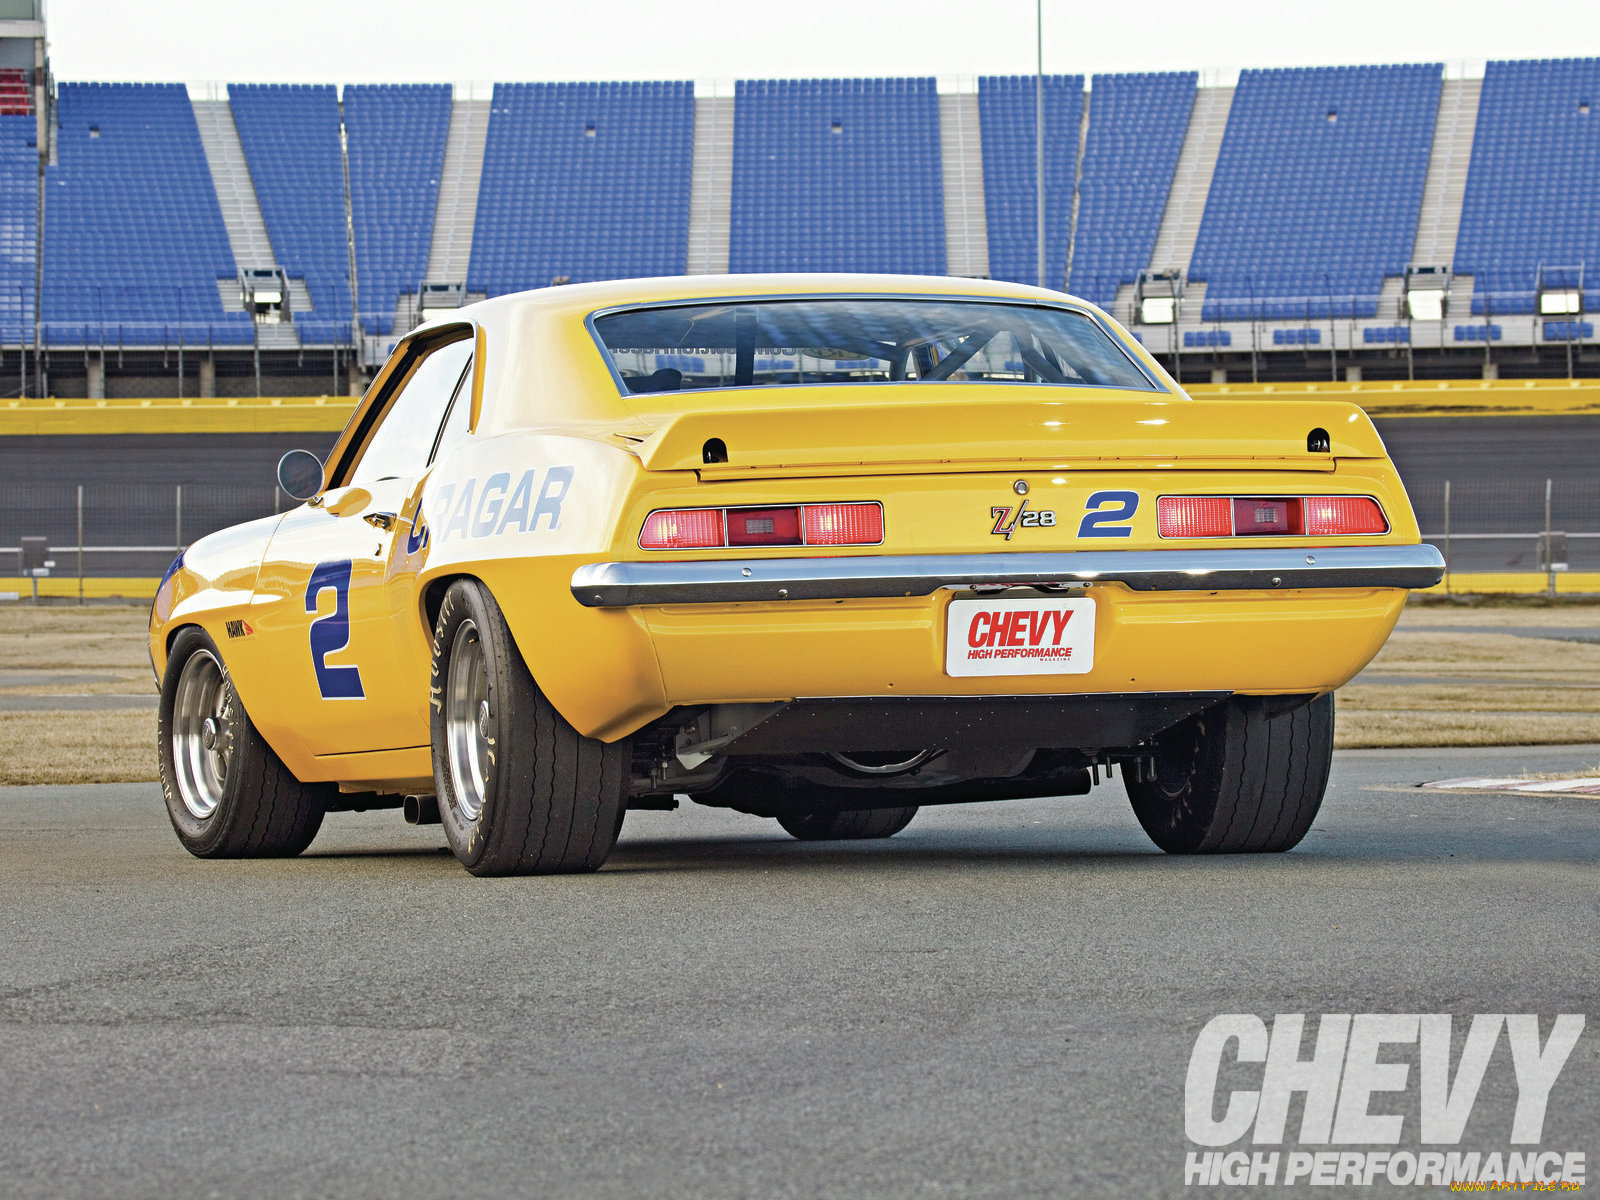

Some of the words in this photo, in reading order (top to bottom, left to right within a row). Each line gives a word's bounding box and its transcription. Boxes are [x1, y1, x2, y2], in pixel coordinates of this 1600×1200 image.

[991, 499, 1057, 540] Z/28
[1077, 490, 1140, 538] 2
[225, 619, 245, 639] HAWK
[305, 557, 366, 700] 2
[968, 610, 1074, 648] CHEVY
[967, 649, 996, 660] HIGH
[994, 648, 1072, 659] PERFORMANCE
